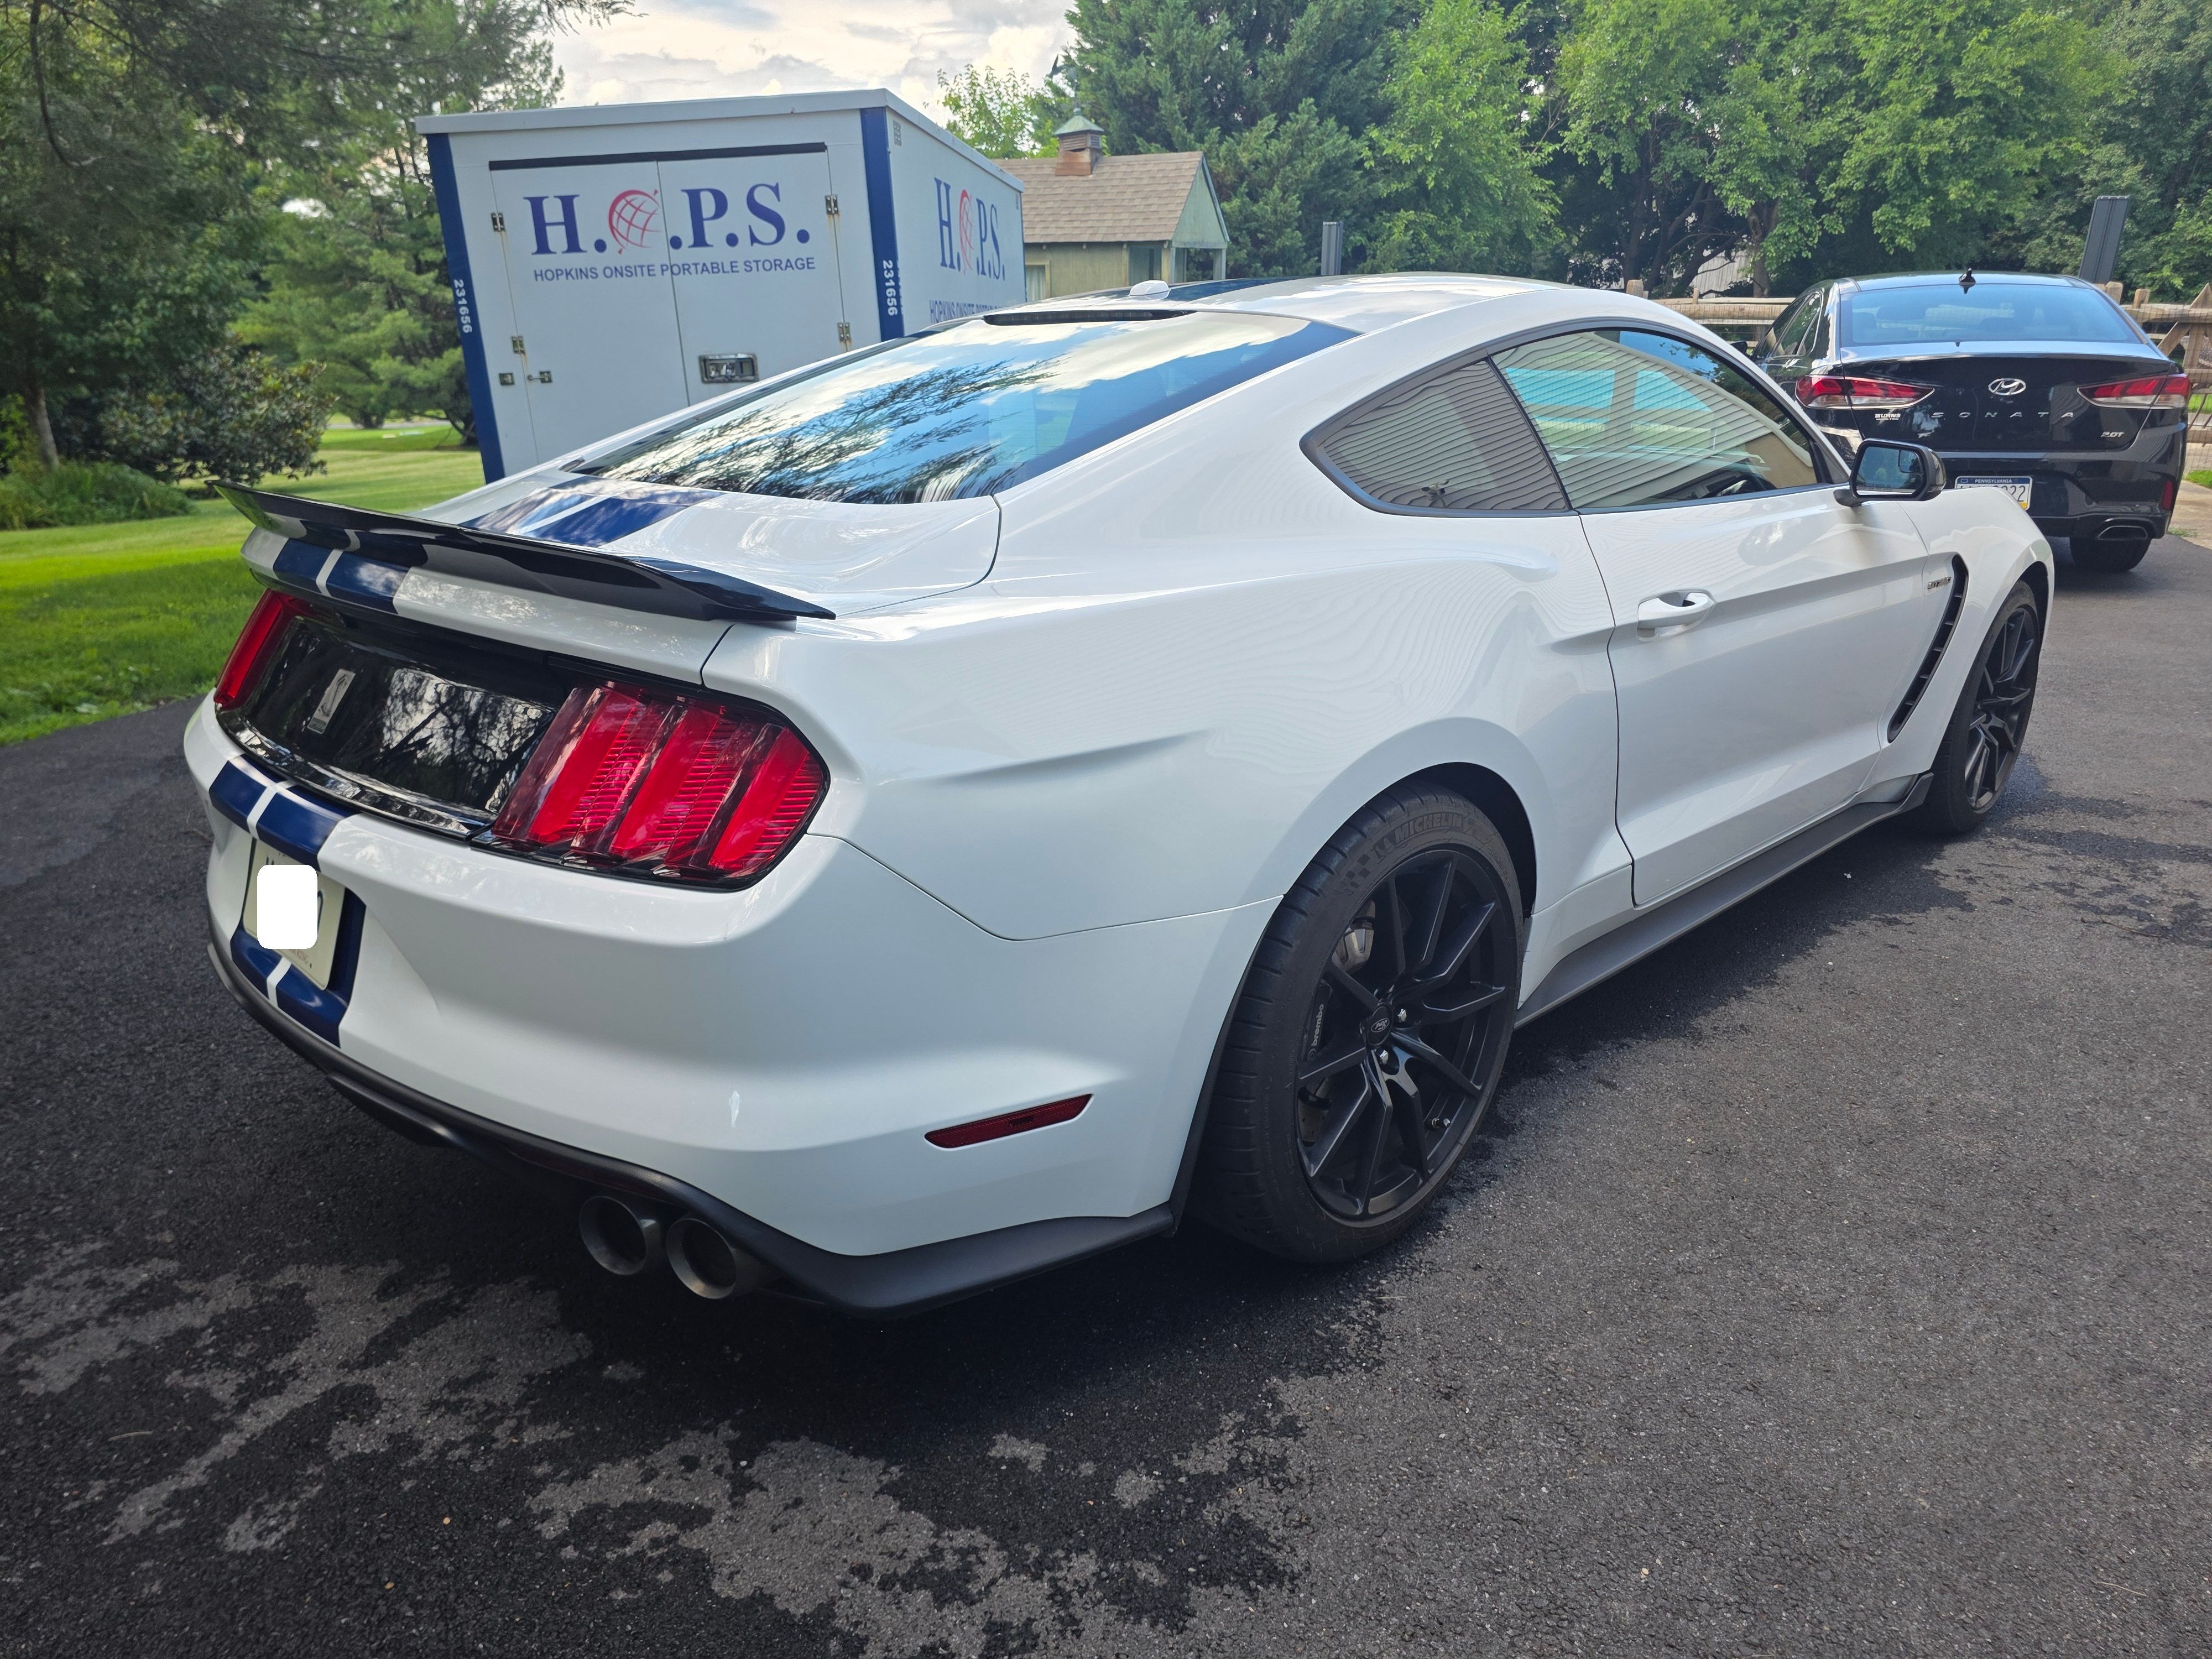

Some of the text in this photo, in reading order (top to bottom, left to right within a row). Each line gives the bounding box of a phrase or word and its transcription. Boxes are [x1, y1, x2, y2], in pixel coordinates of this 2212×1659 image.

[533, 257, 816, 282] HOPKINS ONSITE PORTABLE STORAGE
[883, 259, 898, 316] 231656
[454, 279, 472, 333] 231656
[1395, 813, 1462, 843] MICHELIN
[1311, 1004, 1324, 1046] brembo
